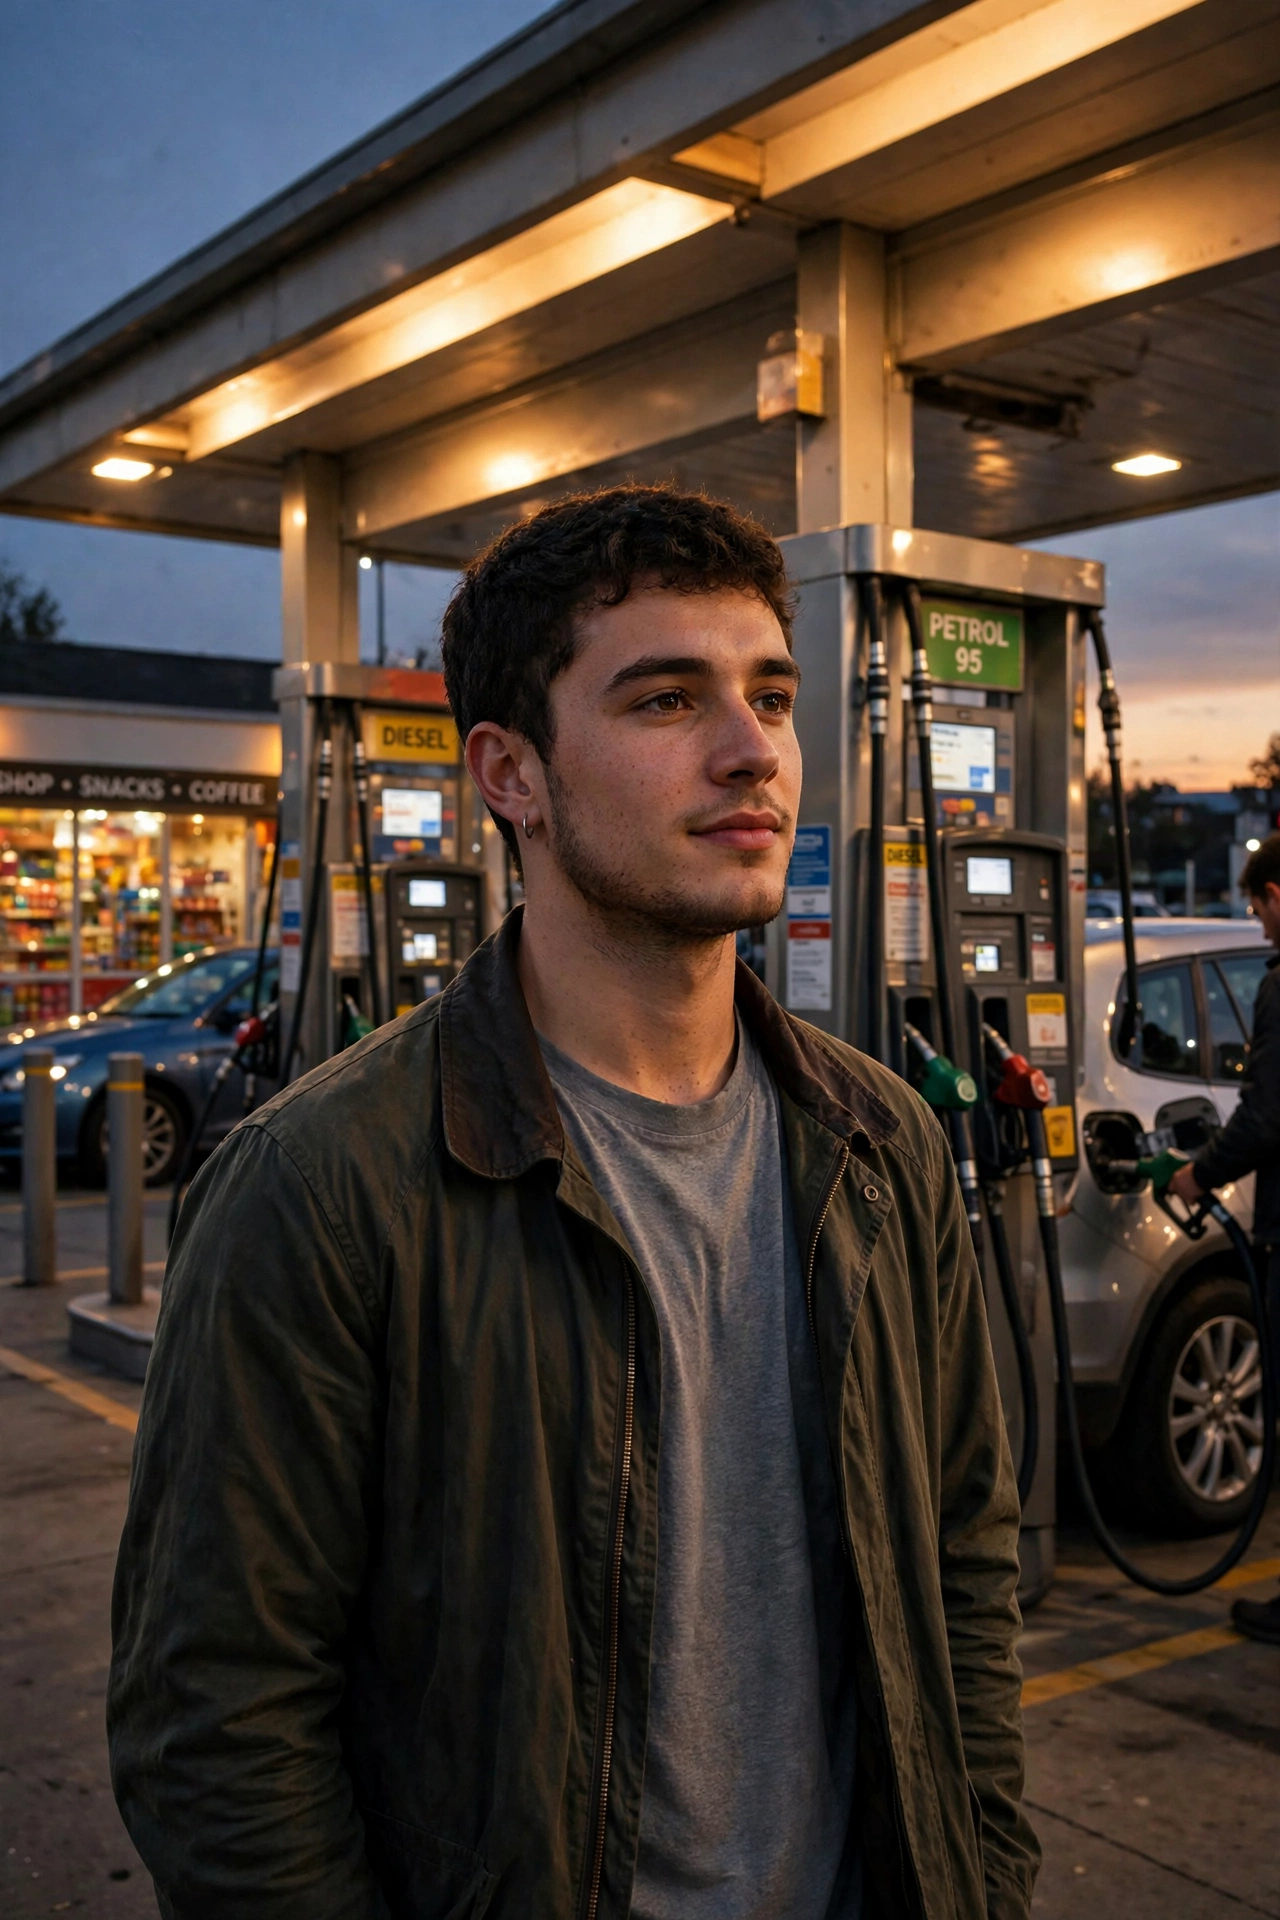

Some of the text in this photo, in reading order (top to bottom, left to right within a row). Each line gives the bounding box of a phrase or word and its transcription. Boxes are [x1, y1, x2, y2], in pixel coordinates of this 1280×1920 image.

[930, 612, 1009, 648] PETROL
[955, 646, 983, 674] 95
[383, 725, 449, 751] DIESEL
[79, 774, 165, 801] SNACKS
[189, 779, 265, 805] COFFEE
